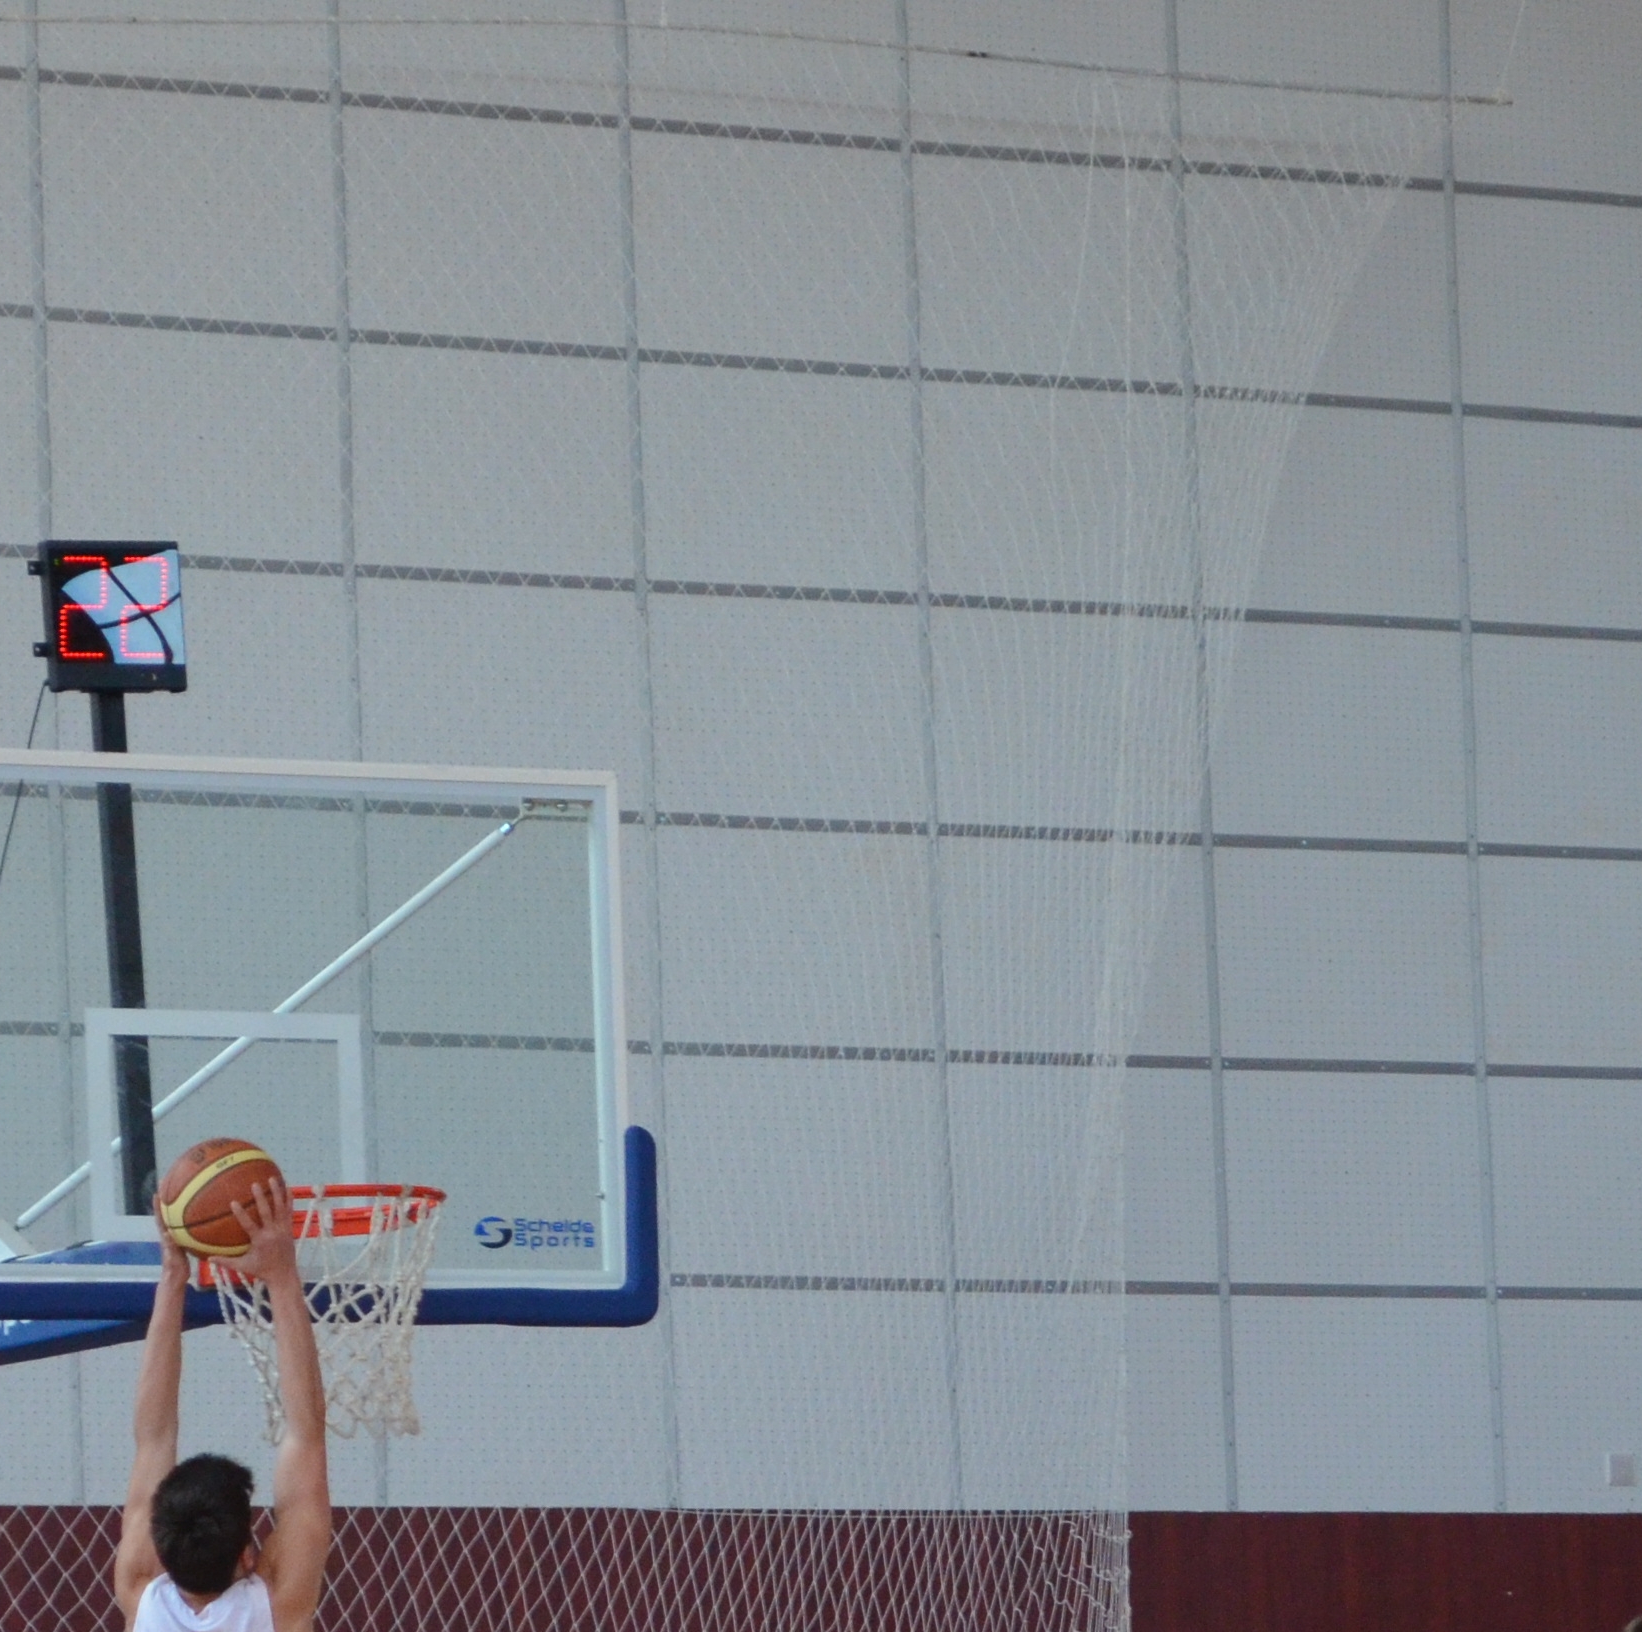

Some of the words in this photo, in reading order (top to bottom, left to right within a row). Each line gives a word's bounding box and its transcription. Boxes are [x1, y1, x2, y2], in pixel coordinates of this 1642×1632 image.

[60, 555, 168, 658] 22
[514, 1218, 595, 1233] Schelde
[514, 1233, 595, 1250] Sports
